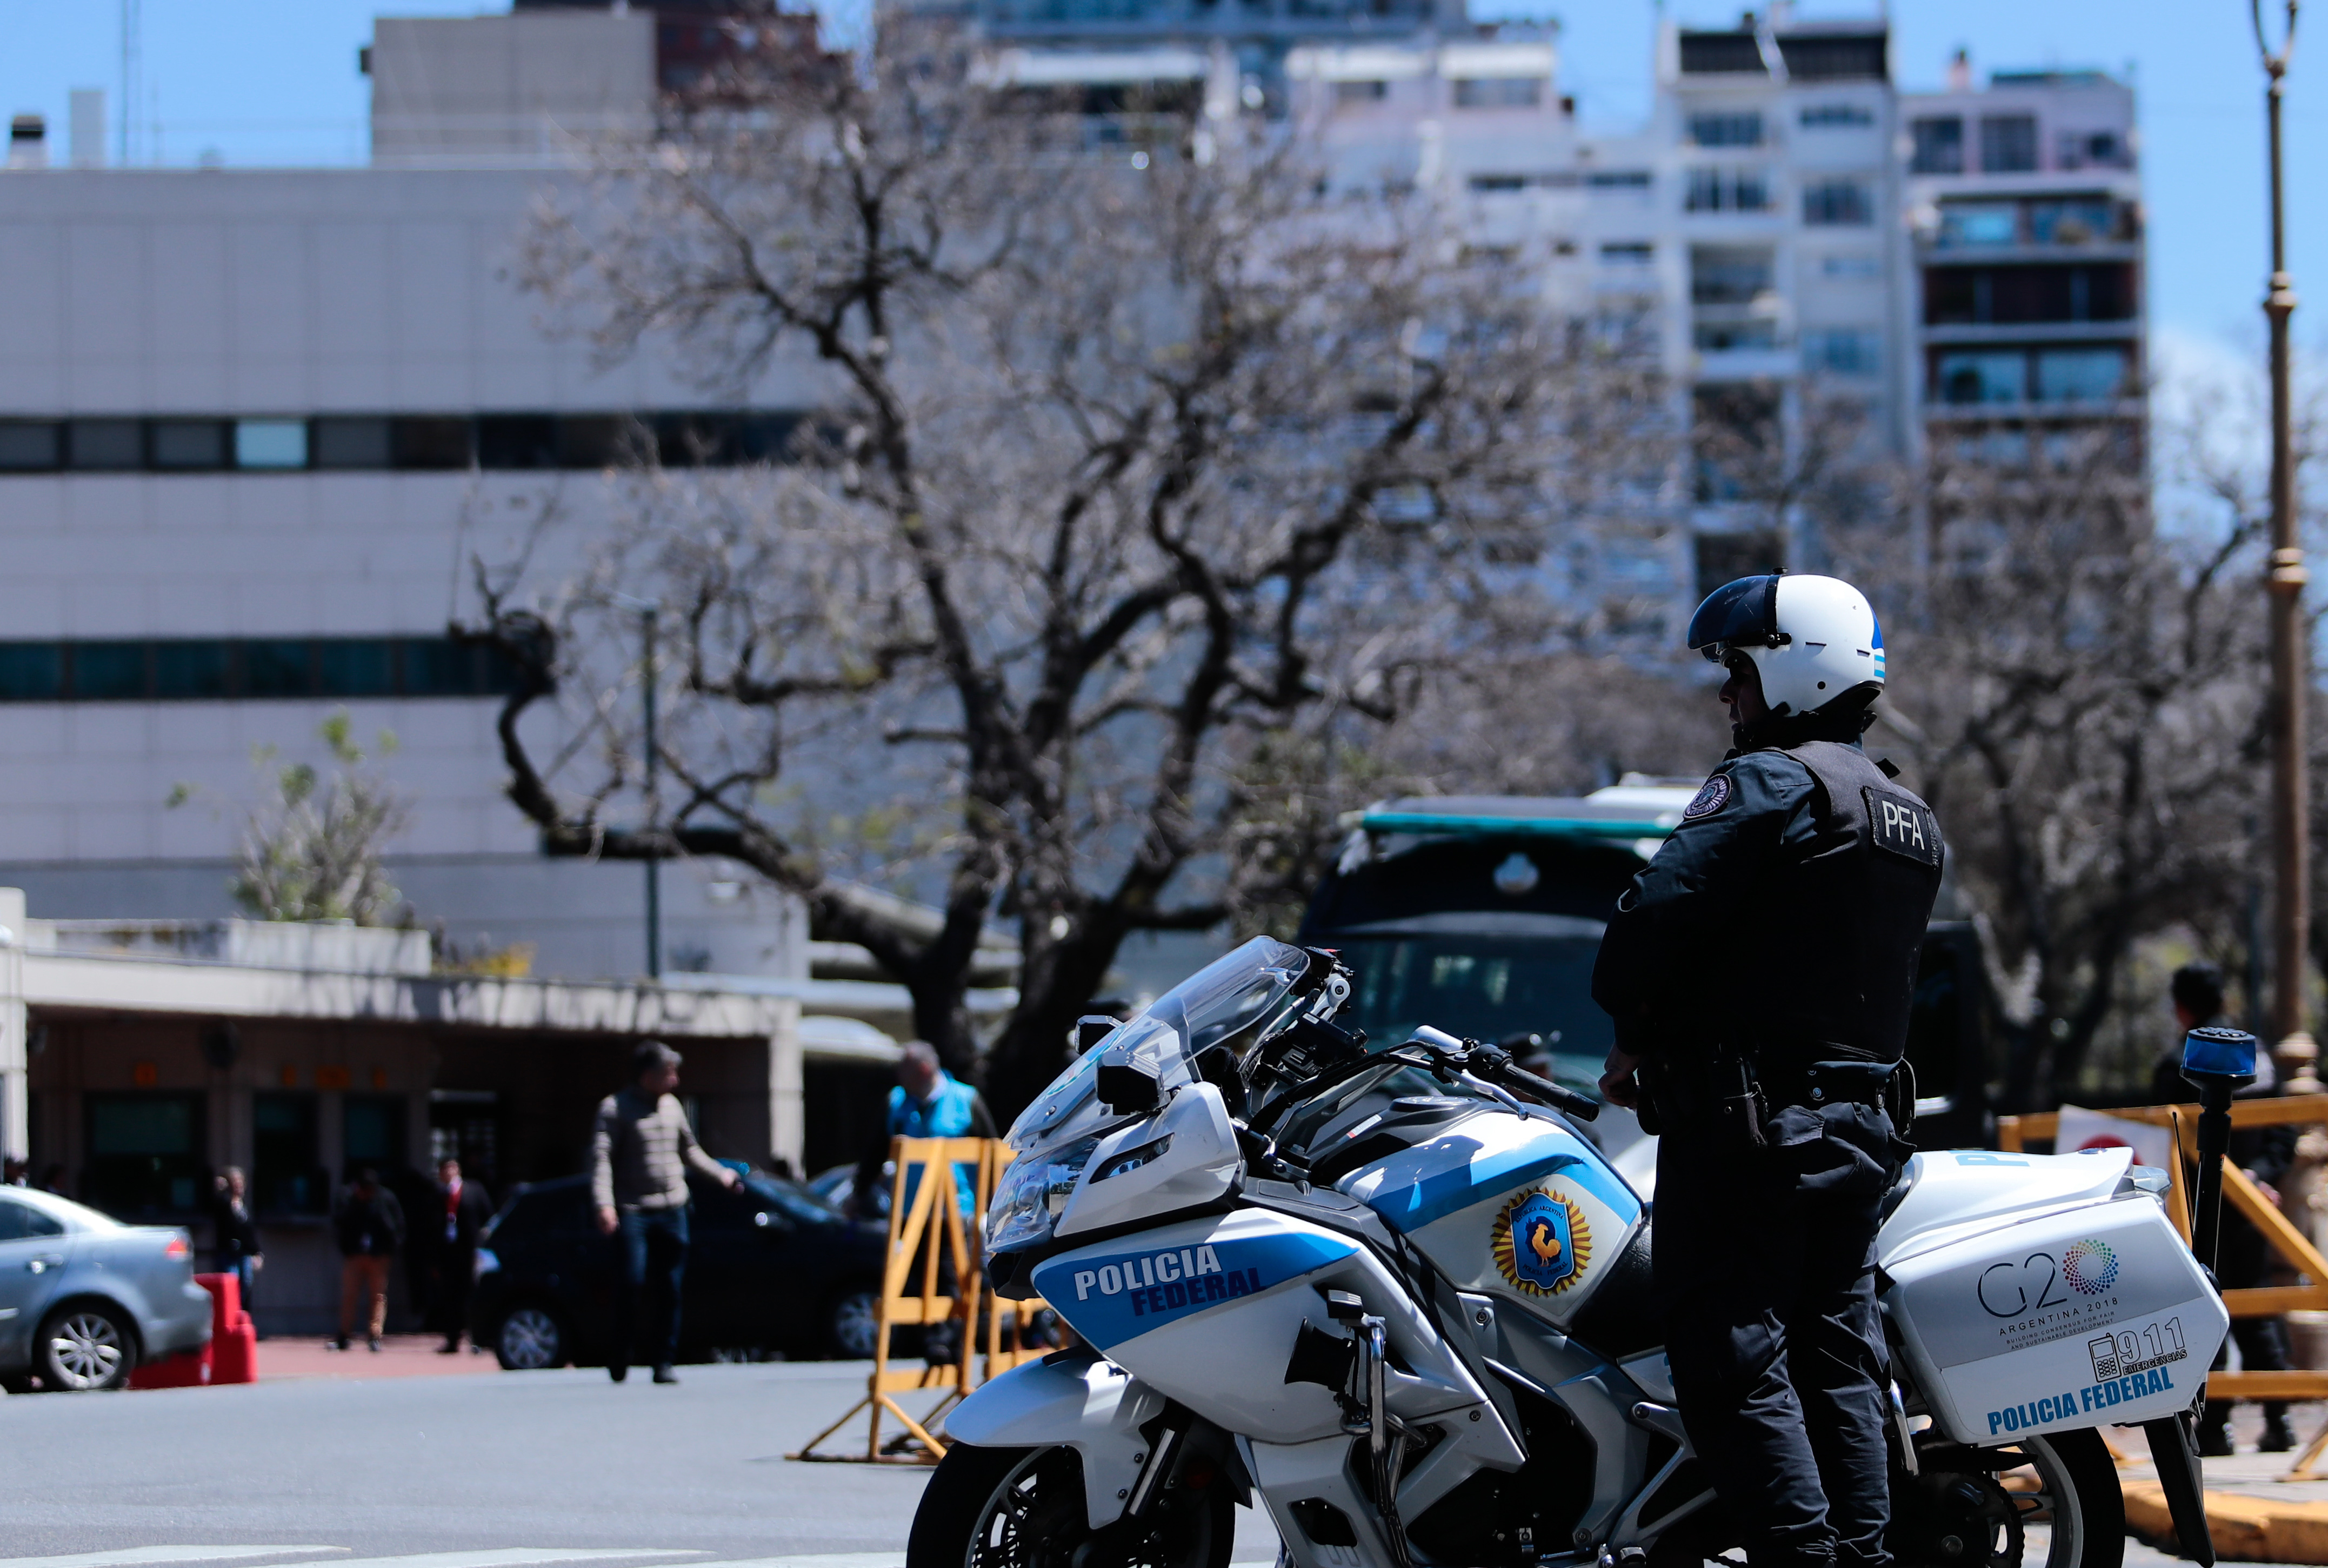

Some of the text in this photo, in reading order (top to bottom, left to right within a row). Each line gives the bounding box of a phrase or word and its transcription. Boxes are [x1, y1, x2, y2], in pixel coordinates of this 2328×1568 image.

[1881, 800, 1925, 851] PFA
[1539, 1205, 1564, 1220] ARGENTINA
[1073, 1244, 1223, 1302] POLICIA
[1547, 1261, 1569, 1276] FEDERAL
[1130, 1266, 1267, 1317] FEDERAL
[1999, 1297, 2118, 1336] ARGENTINA 2018
[2006, 1310, 2115, 1344] BUILDING CONSENSUS FOR FAIR
[2025, 1330, 2067, 1347] SUSTAINABLE
[2068, 1318, 2114, 1335] DEVELOPMENT
[2116, 1316, 2186, 1365] 911
[2122, 1349, 2188, 1376] EMERGENCIAS
[1987, 1365, 2175, 1436] POLICIA FEDERAL
